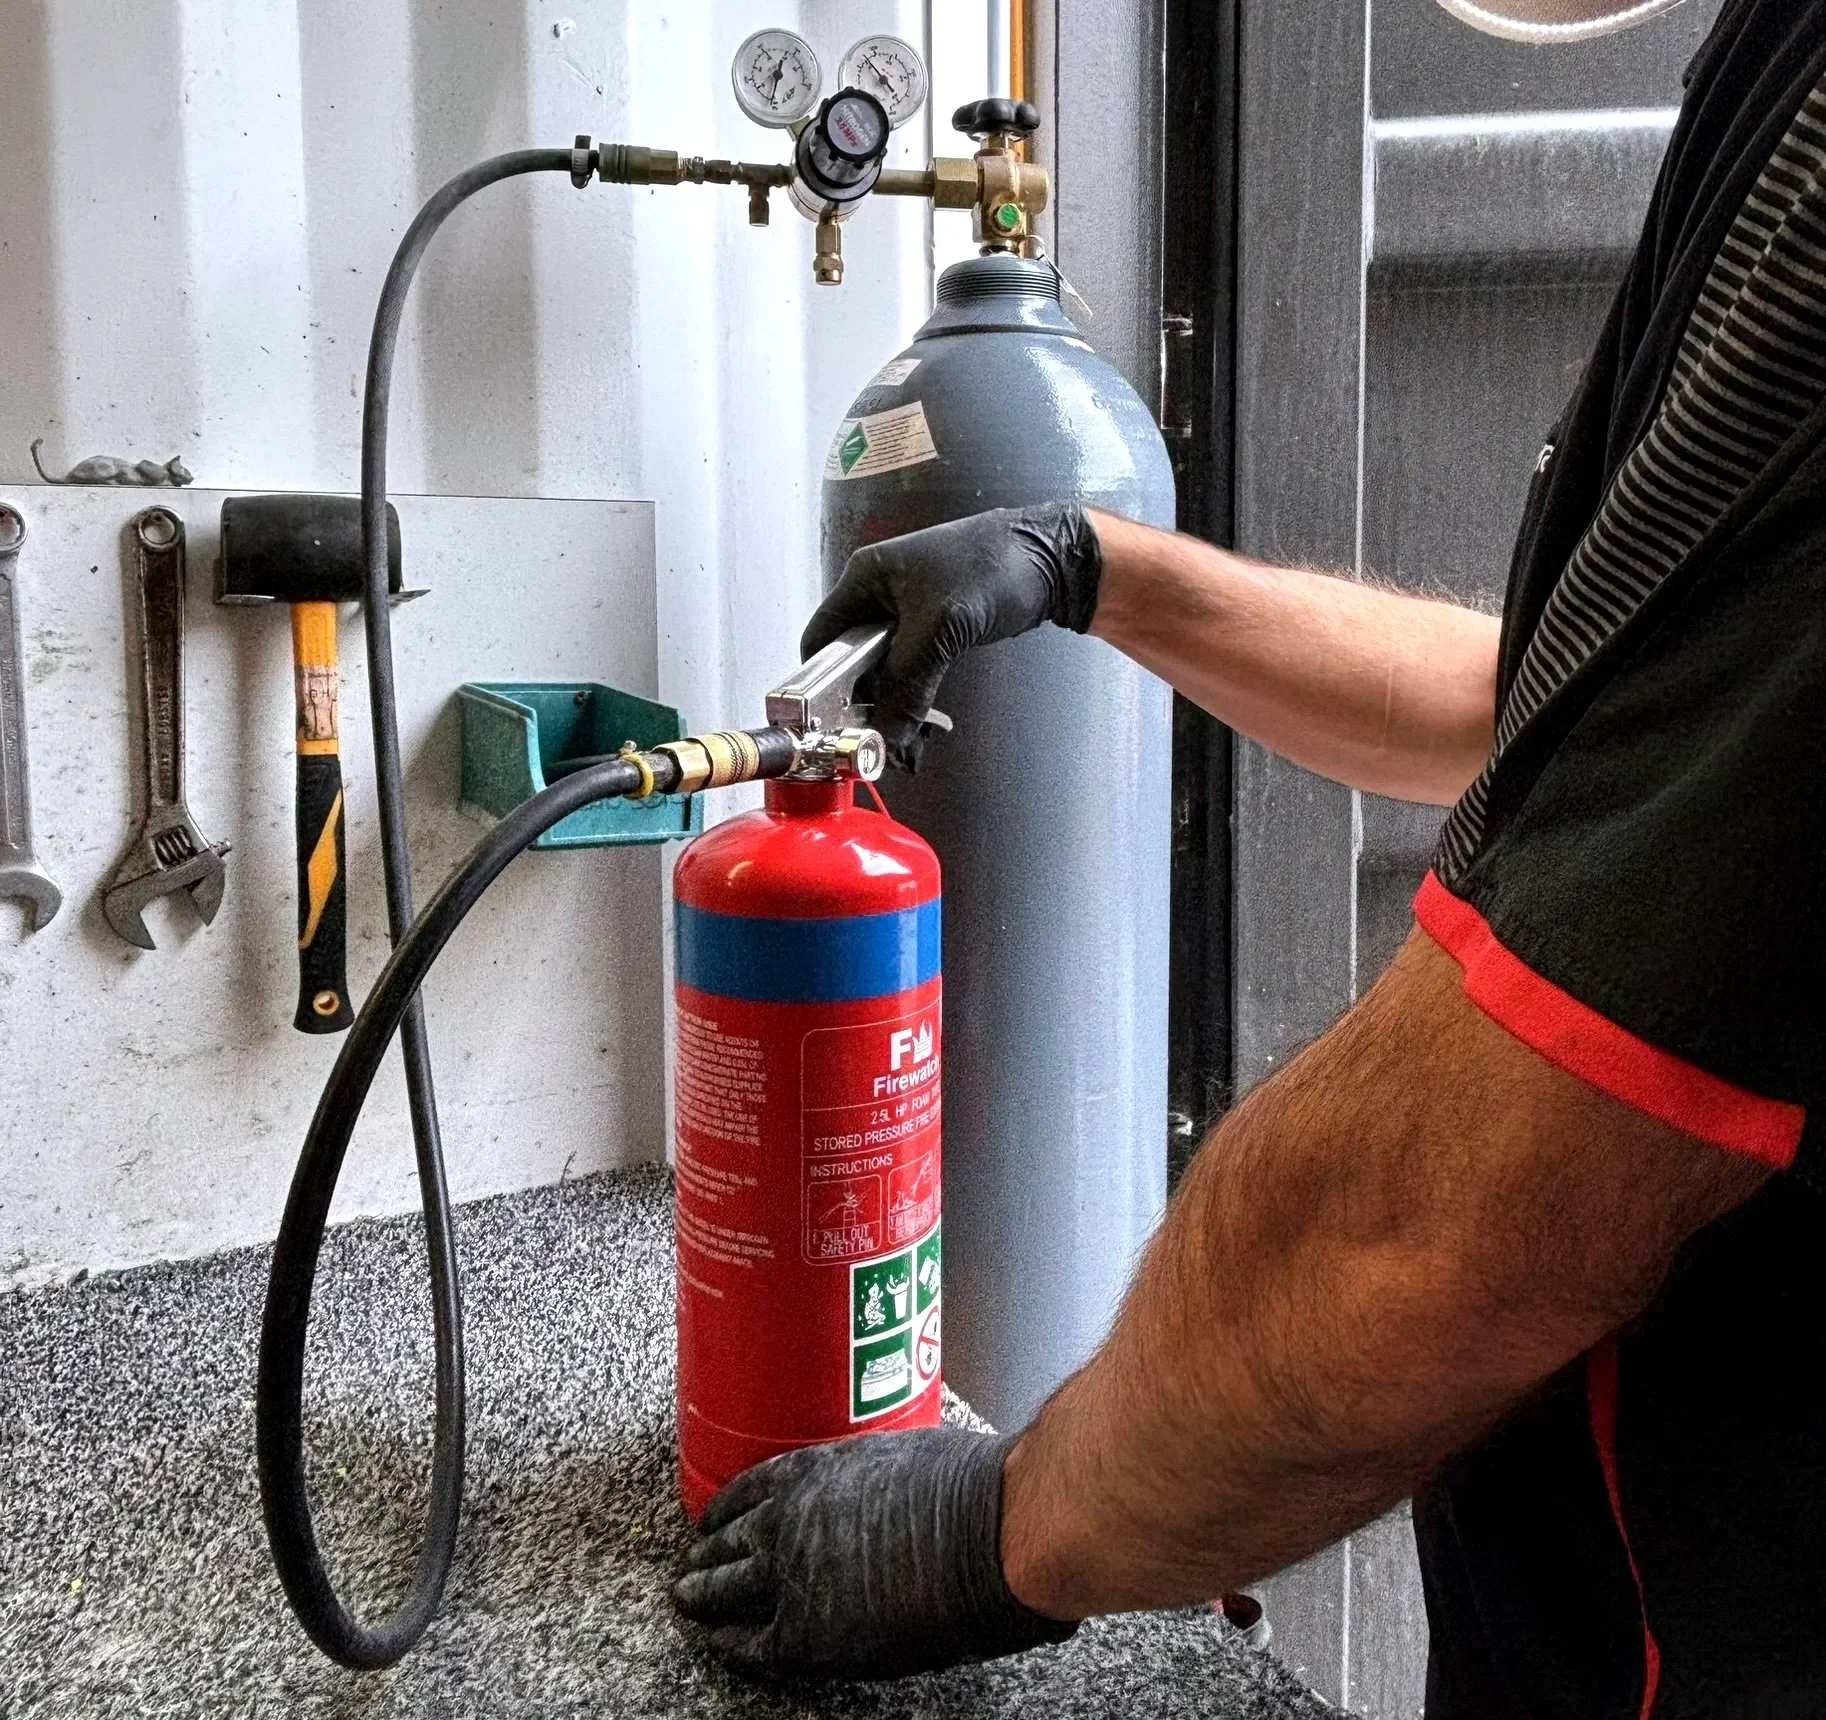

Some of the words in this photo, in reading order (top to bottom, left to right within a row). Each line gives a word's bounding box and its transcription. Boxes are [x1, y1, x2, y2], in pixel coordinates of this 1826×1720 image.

[814, 1133, 862, 1152] STORED
[864, 1118, 915, 1146] PRESSURE
[810, 1153, 893, 1177] INSTRUCTIONS
[850, 1224, 870, 1241] OUT
[820, 1239, 857, 1256] SAFETY
